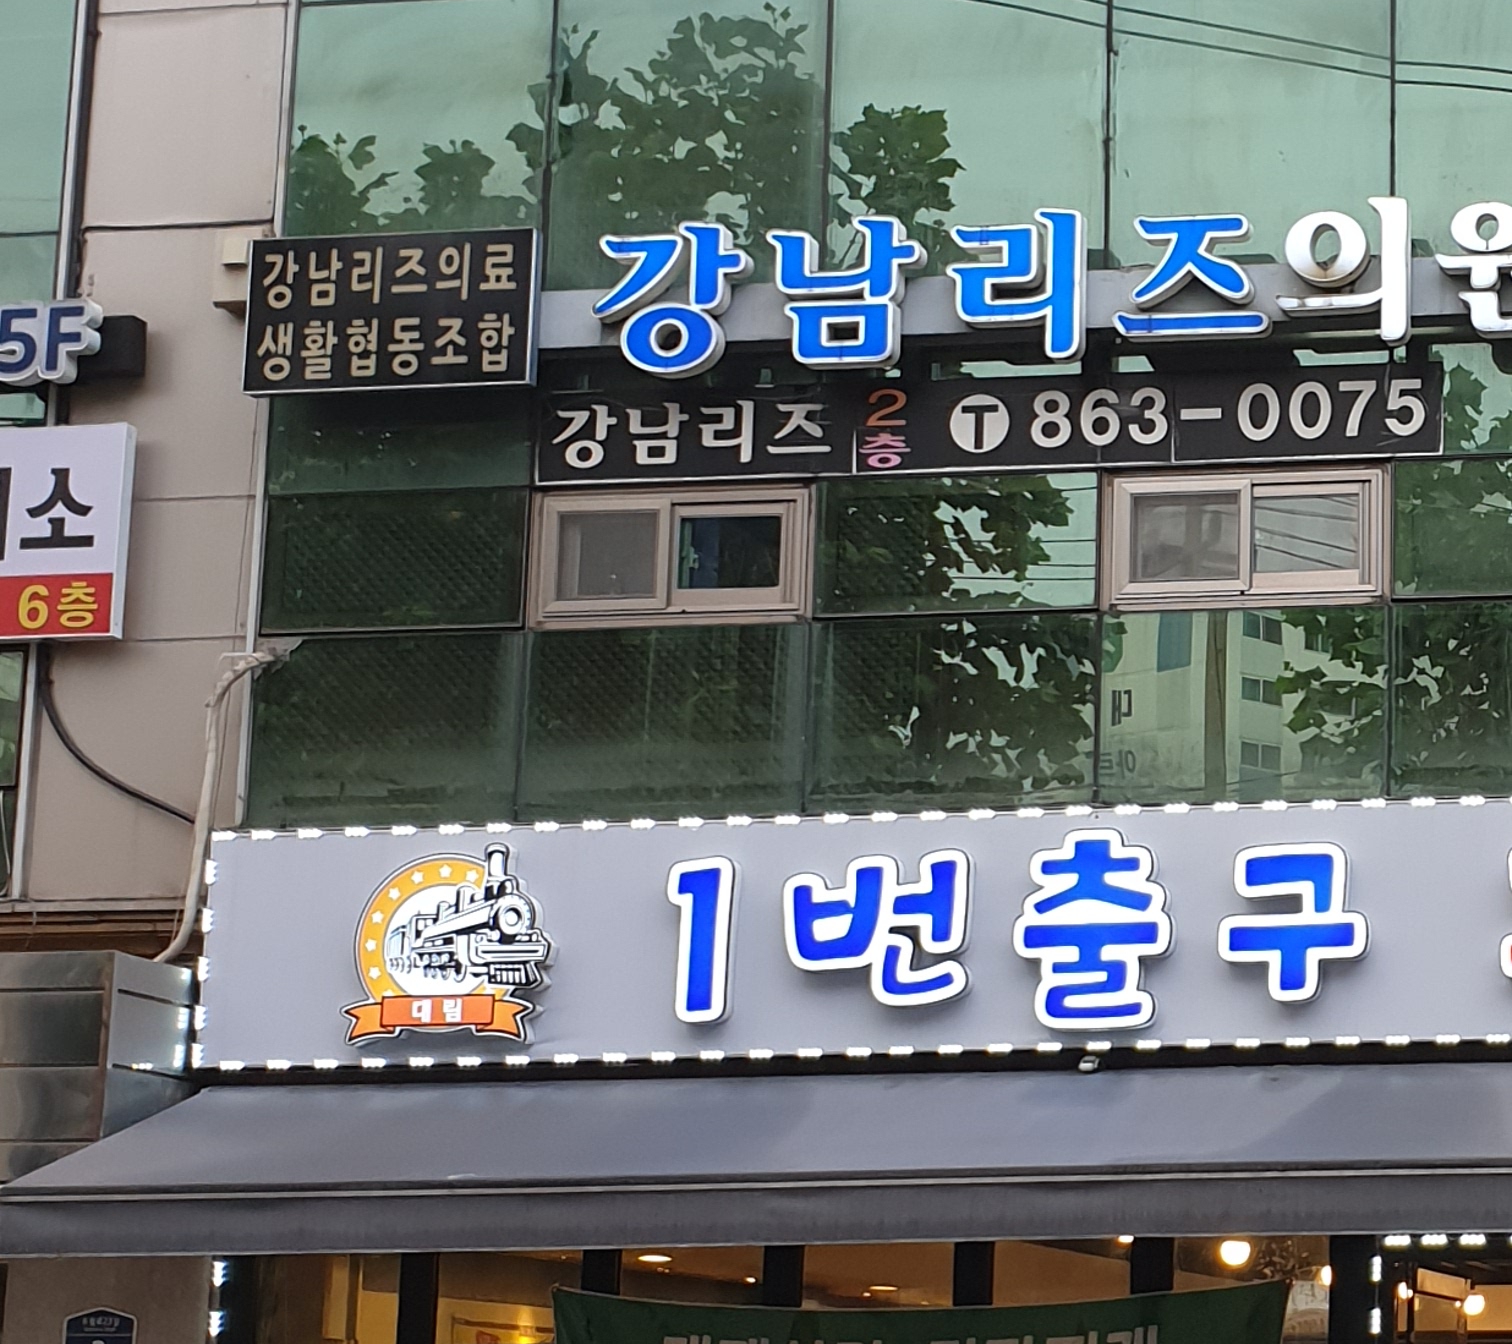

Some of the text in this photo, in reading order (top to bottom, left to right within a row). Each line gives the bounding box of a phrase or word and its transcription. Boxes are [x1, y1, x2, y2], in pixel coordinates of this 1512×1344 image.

[262, 242, 517, 310] 강남리즈의료
[256, 312, 516, 381] 생활협동조합
[551, 399, 832, 468] 강남리즈
[1030, 378, 1427, 449] 863-0075
[17, 581, 98, 630] 6층
[668, 829, 1369, 1030] 1번출구
[411, 998, 462, 1023] 대림
